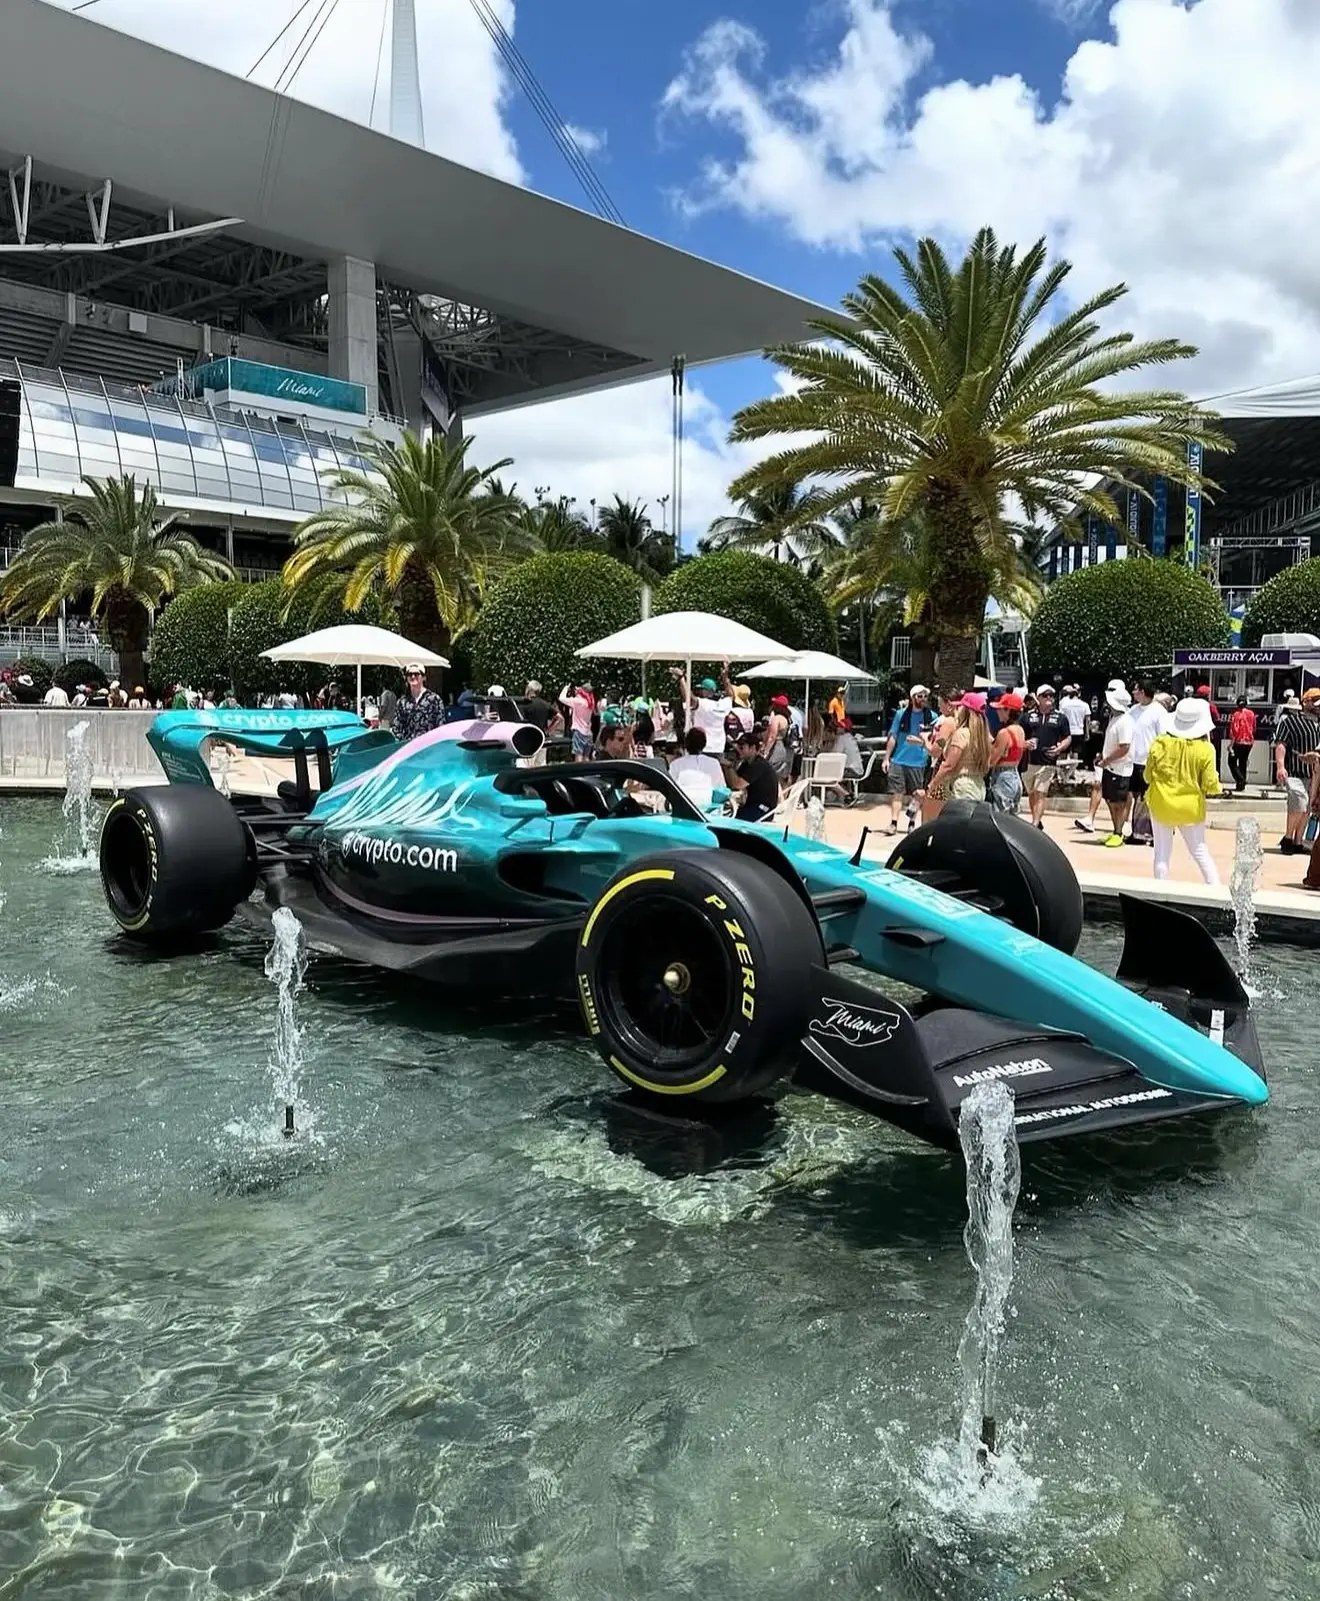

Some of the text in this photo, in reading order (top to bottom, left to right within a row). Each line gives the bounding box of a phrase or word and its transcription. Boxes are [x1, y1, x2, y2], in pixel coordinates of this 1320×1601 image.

[276, 377, 325, 398] Miami
[1188, 652, 1275, 663] OAKBERRY AÇAI
[136, 808, 158, 883] P ZERO
[352, 833, 458, 872] crypto.com
[704, 893, 756, 1021] P ZERO
[825, 1008, 887, 1035] Miami
[953, 1058, 1051, 1088] AutoNation
[1089, 1088, 1173, 1110] AUTODROME
